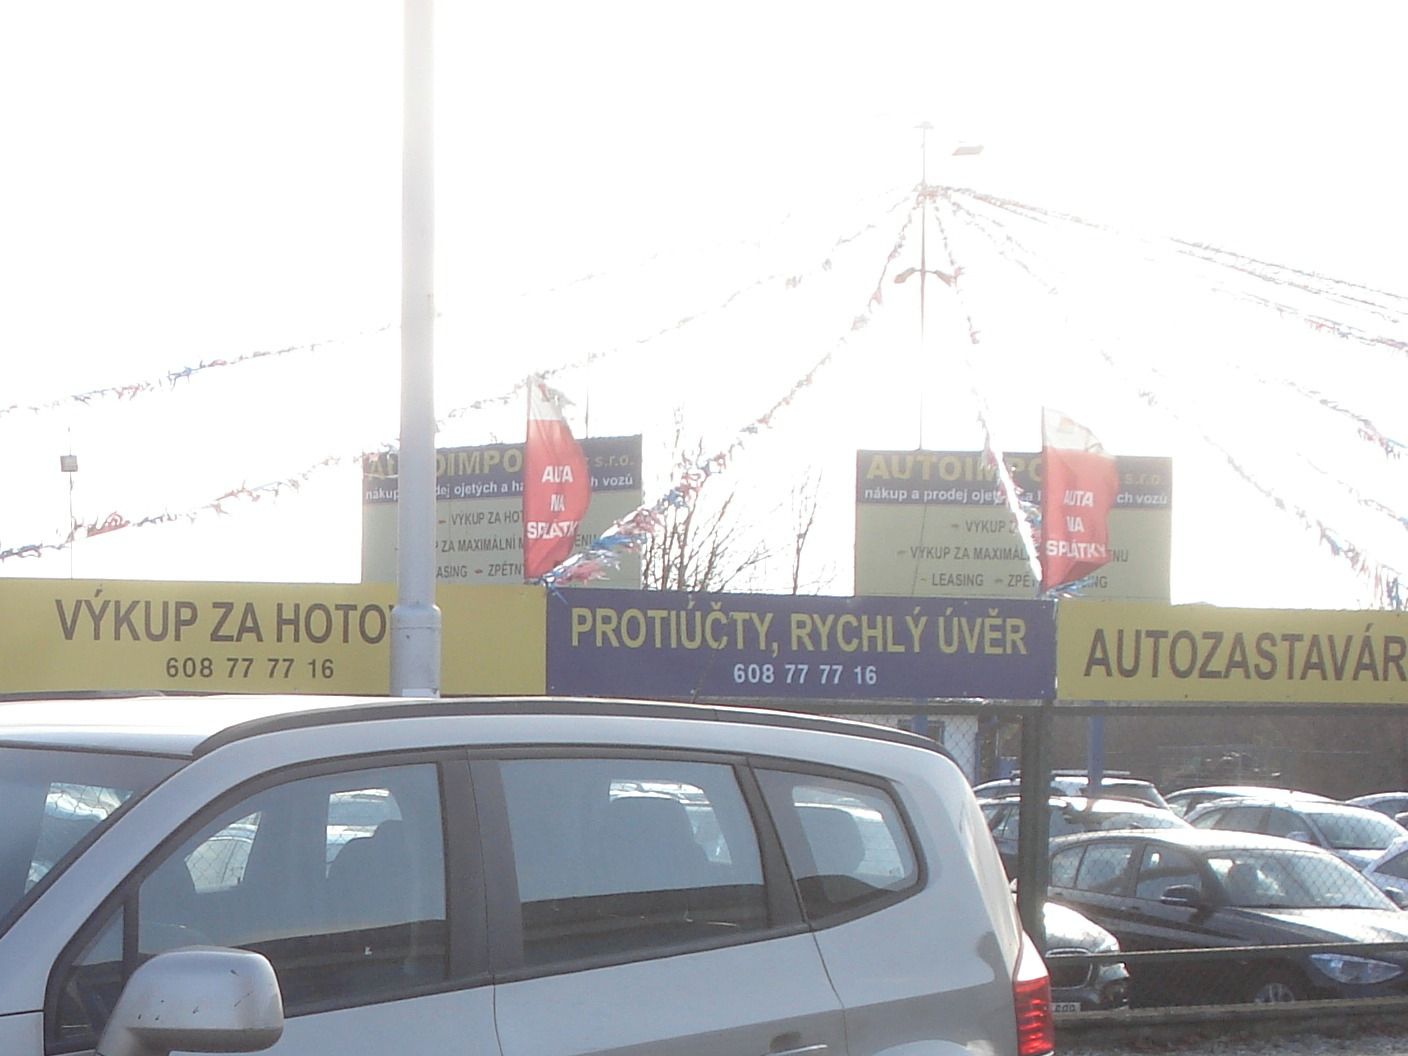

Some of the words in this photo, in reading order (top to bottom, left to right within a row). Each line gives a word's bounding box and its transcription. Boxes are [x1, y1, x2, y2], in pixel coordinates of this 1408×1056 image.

[454, 481, 497, 498] ojetých
[865, 487, 907, 502] nákup
[911, 490, 919, 500] a
[924, 488, 967, 504] prodej
[487, 511, 501, 524] ZA
[458, 535, 516, 552] MAXIMÁLNÍ
[953, 546, 970, 560] ZA
[931, 573, 984, 587] LEASING
[55, 584, 198, 643] VÝKUP
[209, 601, 263, 643] ZA
[276, 602, 392, 645] HOTO
[570, 599, 779, 657] PROTIÚČTY,
[790, 605, 927, 653] RYCHLÝ
[938, 605, 1027, 655] ÚVĚR
[166, 657, 213, 679] 608
[226, 658, 254, 679] 77
[267, 658, 295, 679] 77
[308, 658, 334, 679] 16
[733, 663, 775, 684] 608
[784, 664, 809, 685] 77
[819, 664, 843, 685] 77
[854, 665, 878, 685] 16
